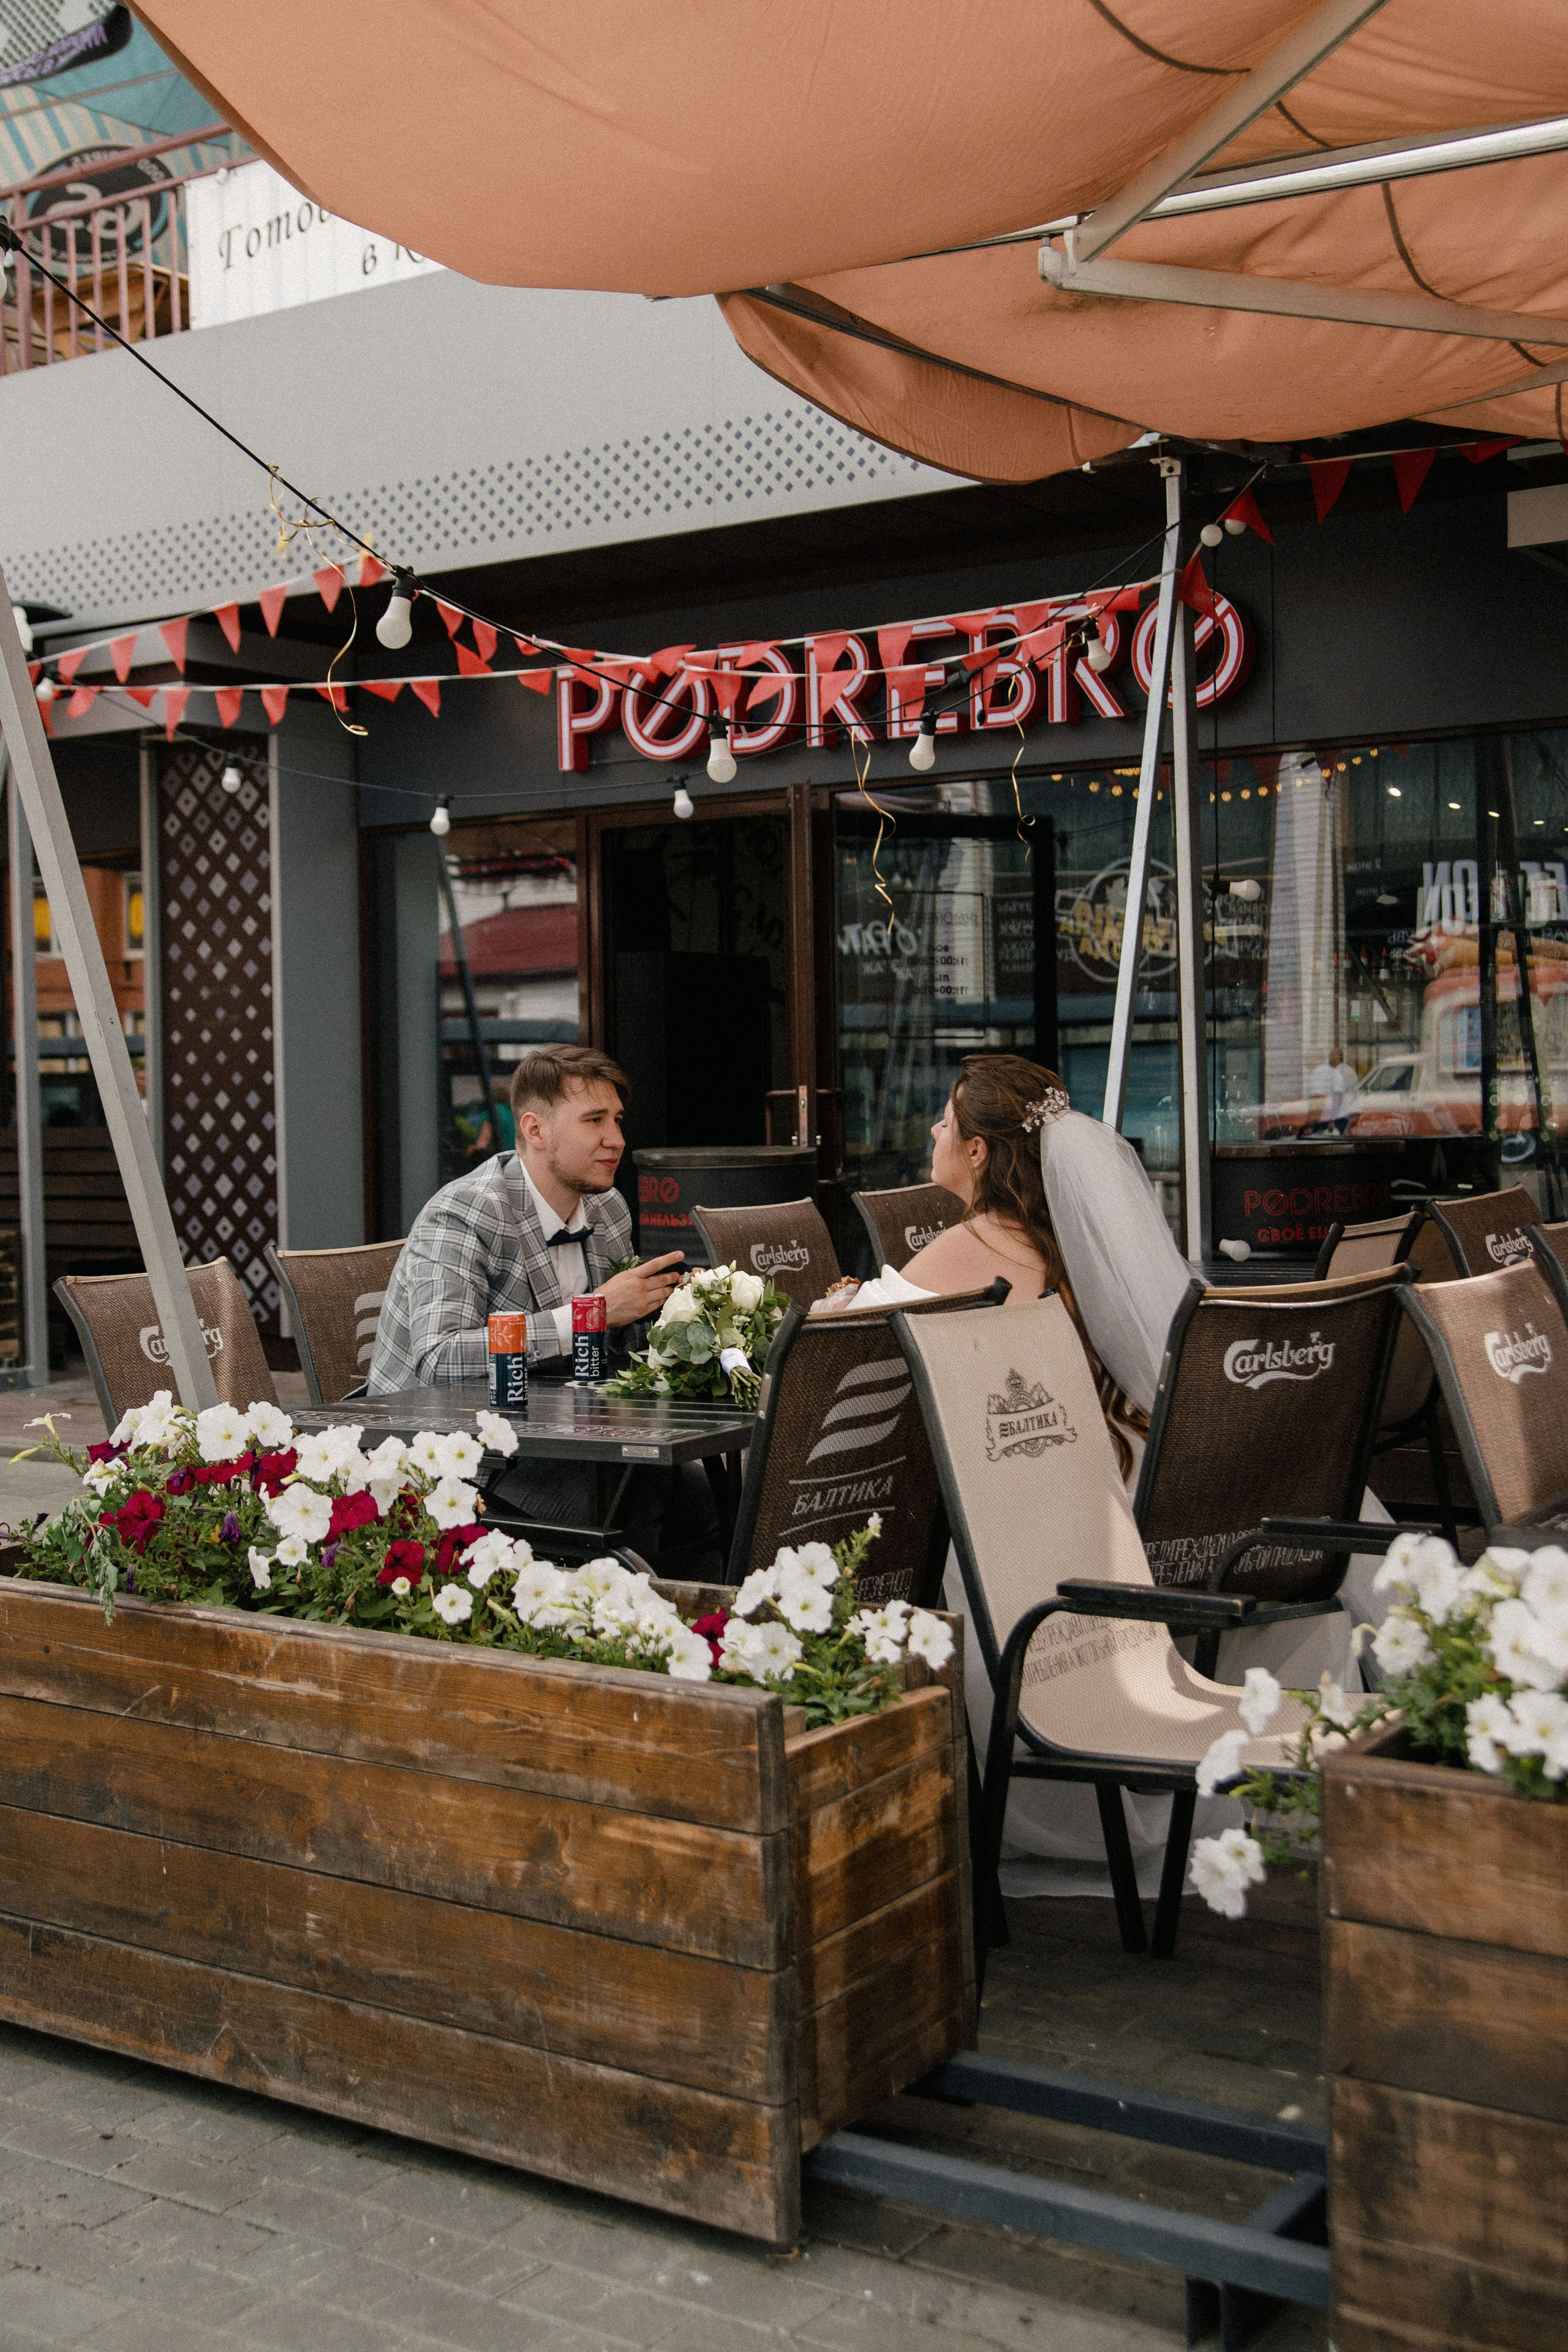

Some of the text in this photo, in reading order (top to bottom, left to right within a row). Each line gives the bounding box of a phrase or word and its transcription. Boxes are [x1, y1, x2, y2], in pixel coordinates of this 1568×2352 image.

[905, 1220, 947, 1252] Carlsb
[1485, 1227, 1534, 1266] Carlsberg
[750, 1240, 810, 1276] Carlsberg
[575, 1335, 589, 1378] Rich
[590, 1346, 600, 1377] bitter
[1224, 1332, 1335, 1390] Carlsberg
[1484, 1322, 1552, 1385] Carlsberg
[507, 1355, 524, 1402] Rich
[1008, 1411, 1058, 1436] БАЛТИКА
[791, 1475, 894, 1516] БАЛТИКА
[1144, 1532, 1226, 1564] РЕДУПРЕЖДАЕМ
